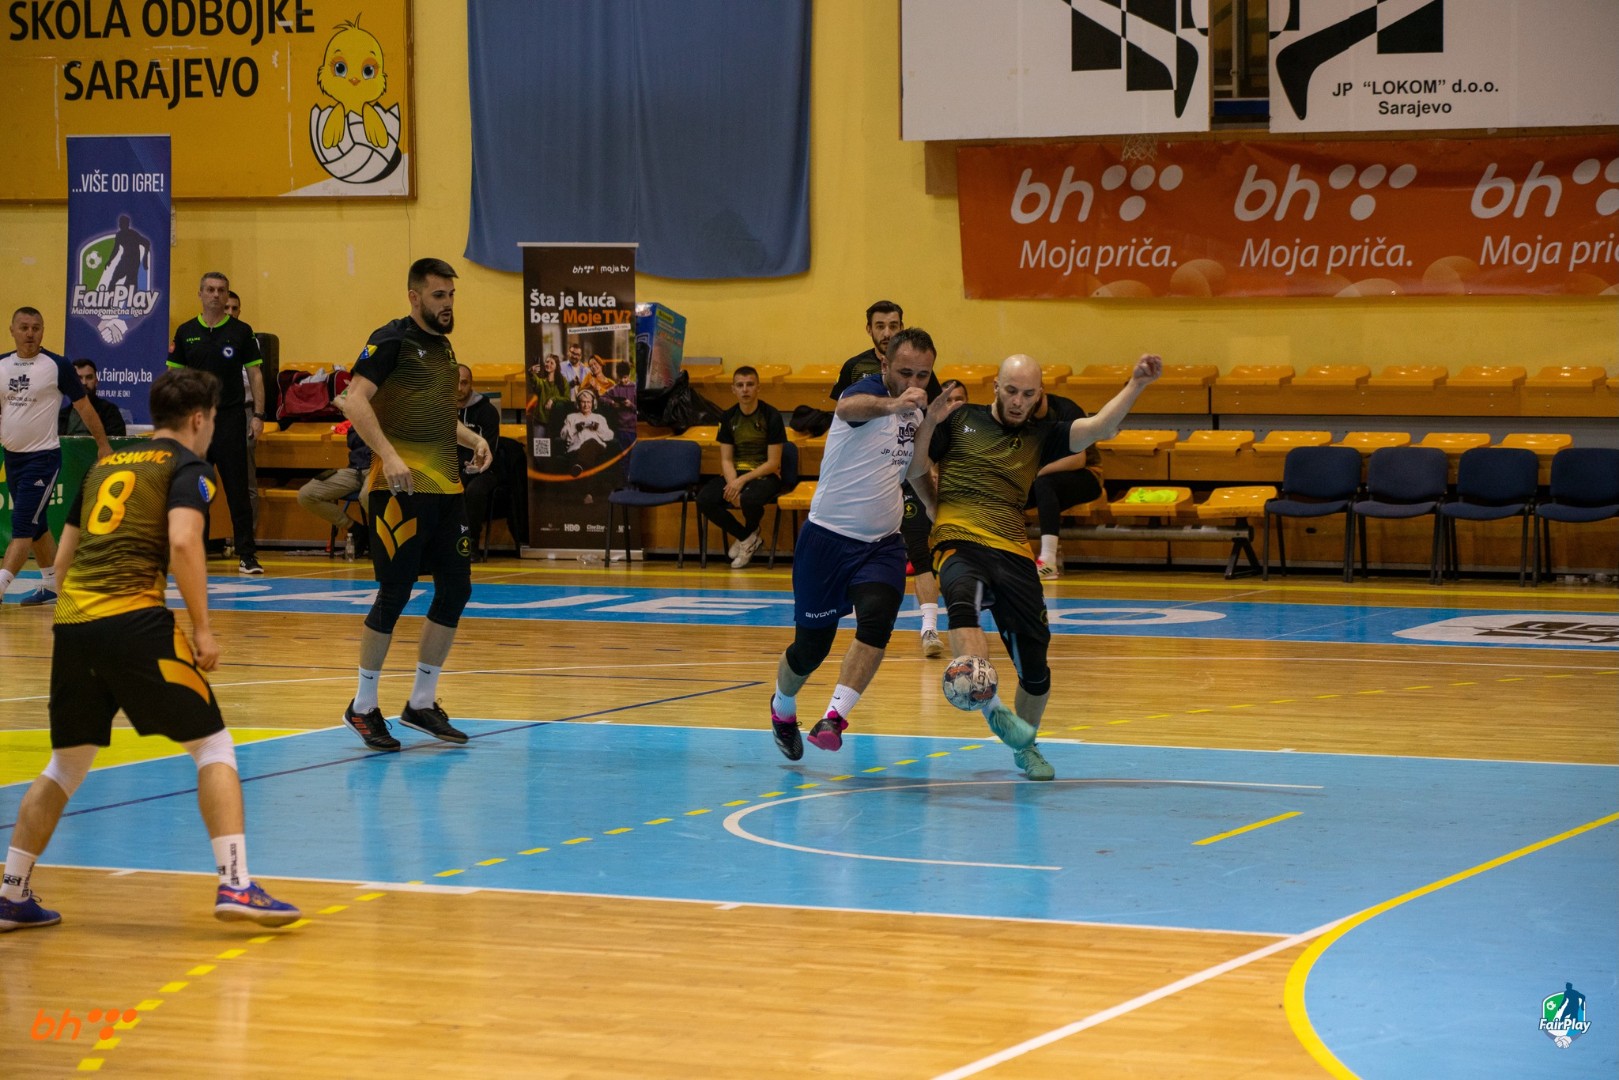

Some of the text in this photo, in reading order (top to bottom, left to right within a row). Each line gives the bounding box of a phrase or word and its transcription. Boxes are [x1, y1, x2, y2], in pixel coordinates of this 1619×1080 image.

[142, 0, 315, 45] ODBOJKE
[63, 56, 260, 110] SARAJEVO
[1331, 81, 1354, 98] JP
[1451, 77, 1500, 95] d.o.o.
[1377, 99, 1453, 118] Sarajevo
[72, 169, 164, 193] ...VIŠE OD IGRE!
[1010, 166, 1095, 225] bh
[1233, 163, 1317, 222] bh
[1470, 161, 1563, 219] bh
[600, 264, 630, 274] moja tv
[1019, 237, 1179, 277] Moja priča.
[1239, 237, 1415, 276] Moja priča.
[1480, 235, 1562, 274] Moja
[73, 284, 160, 315] FairPlay
[530, 289, 616, 310] Šta je kuća
[530, 308, 559, 324] bez
[86, 469, 138, 536] 8
[564, 523, 580, 532] HBO
